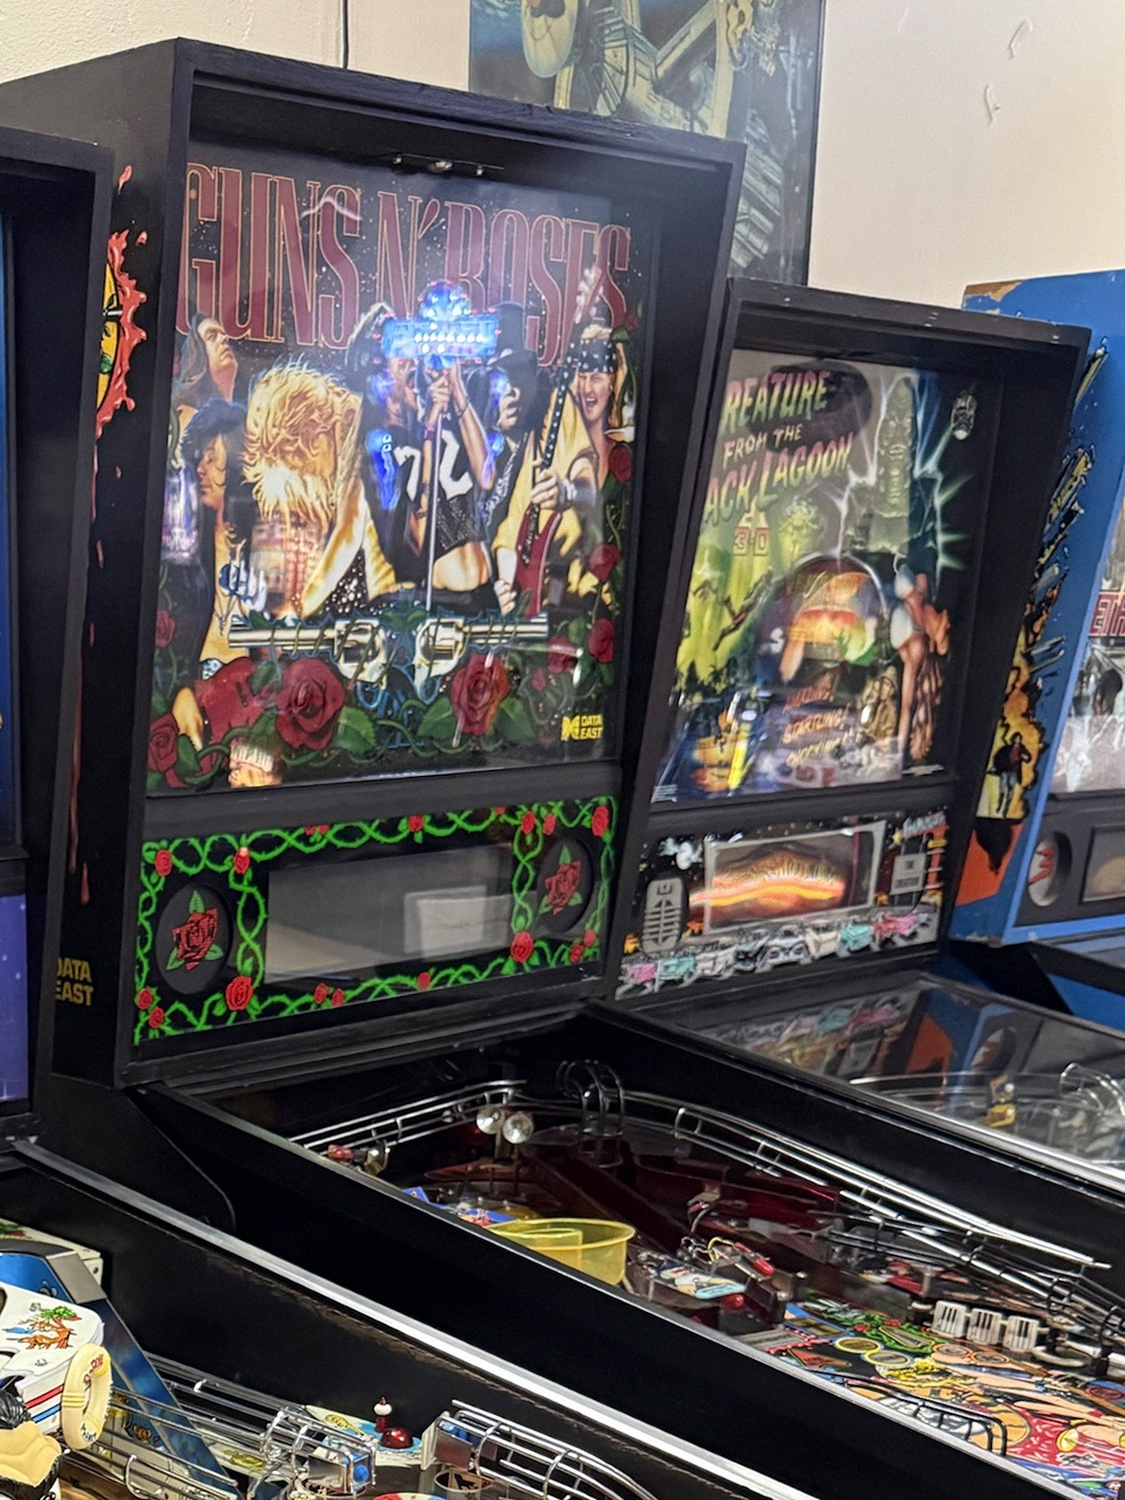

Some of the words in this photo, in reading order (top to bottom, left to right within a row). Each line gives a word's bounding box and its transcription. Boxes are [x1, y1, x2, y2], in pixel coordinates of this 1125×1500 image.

[176, 163, 363, 350] GUNS
[443, 200, 632, 369] ROSES
[723, 431, 768, 470] FROM
[773, 423, 804, 449] THE
[756, 431, 855, 512] LAGOON
[579, 727, 604, 740] EAST
